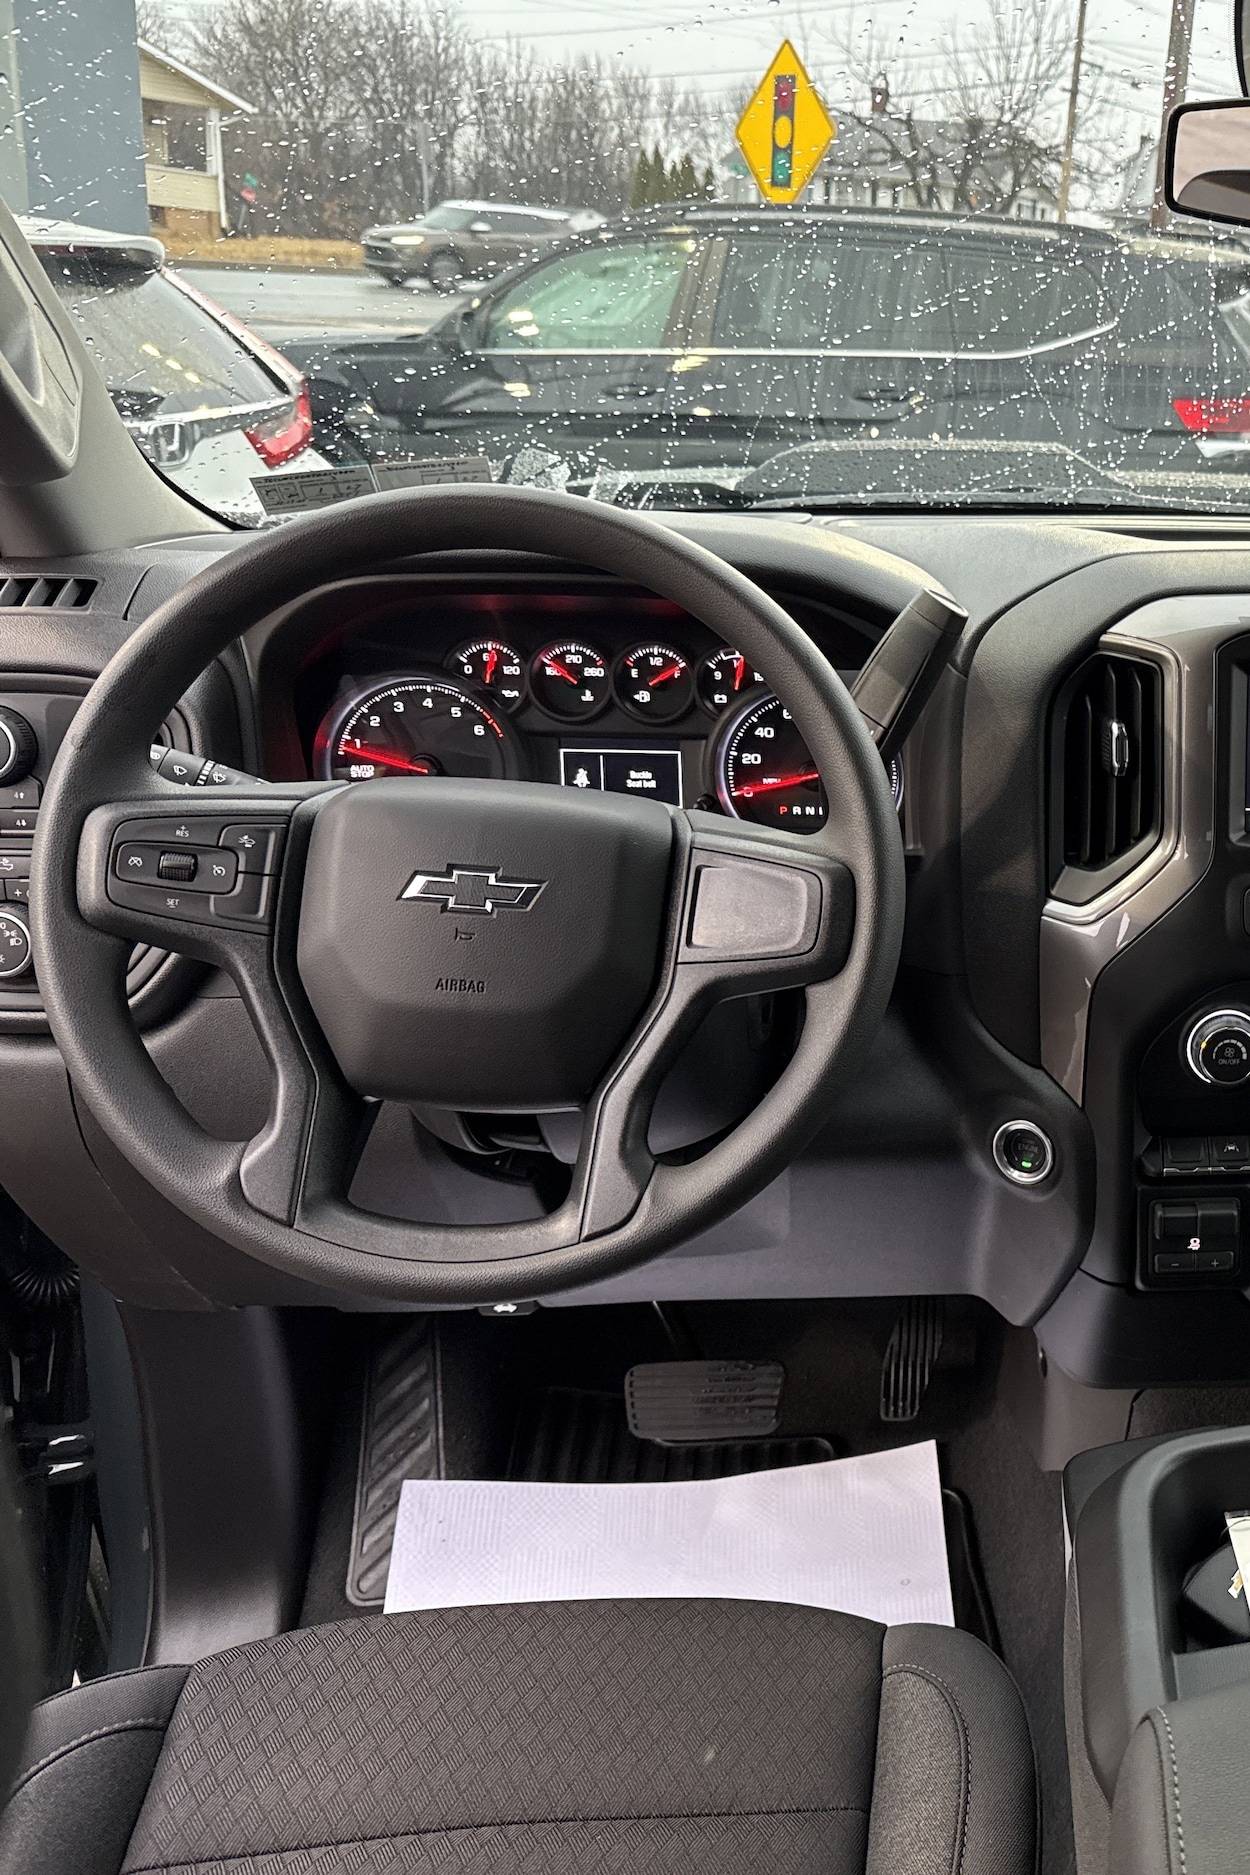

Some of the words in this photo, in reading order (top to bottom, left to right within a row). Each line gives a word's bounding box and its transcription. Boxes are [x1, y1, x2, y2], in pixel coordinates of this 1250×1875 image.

[565, 655, 582, 664] 210
[649, 656, 663, 667] 1/2
[463, 665, 473, 675] 0
[502, 665, 520, 676] 120
[583, 667, 605, 678] 260
[630, 668, 639, 679] E
[674, 671, 681, 679] F
[713, 672, 722, 681] 9
[393, 701, 405, 713] 3
[422, 697, 434, 709] 4
[450, 707, 462, 718] 5
[369, 716, 381, 727] 2
[473, 724, 485, 736] 6
[754, 726, 775, 739] 40
[353, 738, 361, 749] 1
[741, 752, 762, 765] 20
[350, 764, 375, 773] AUTO
[779, 805, 788, 815] P
[792, 805, 802, 816] R
[805, 805, 815, 816] N
[175, 829, 190, 838] RES
[166, 898, 179, 906] SET
[435, 977, 486, 993] AIRBAG
[1218, 1058, 1240, 1066] ON/OFF
